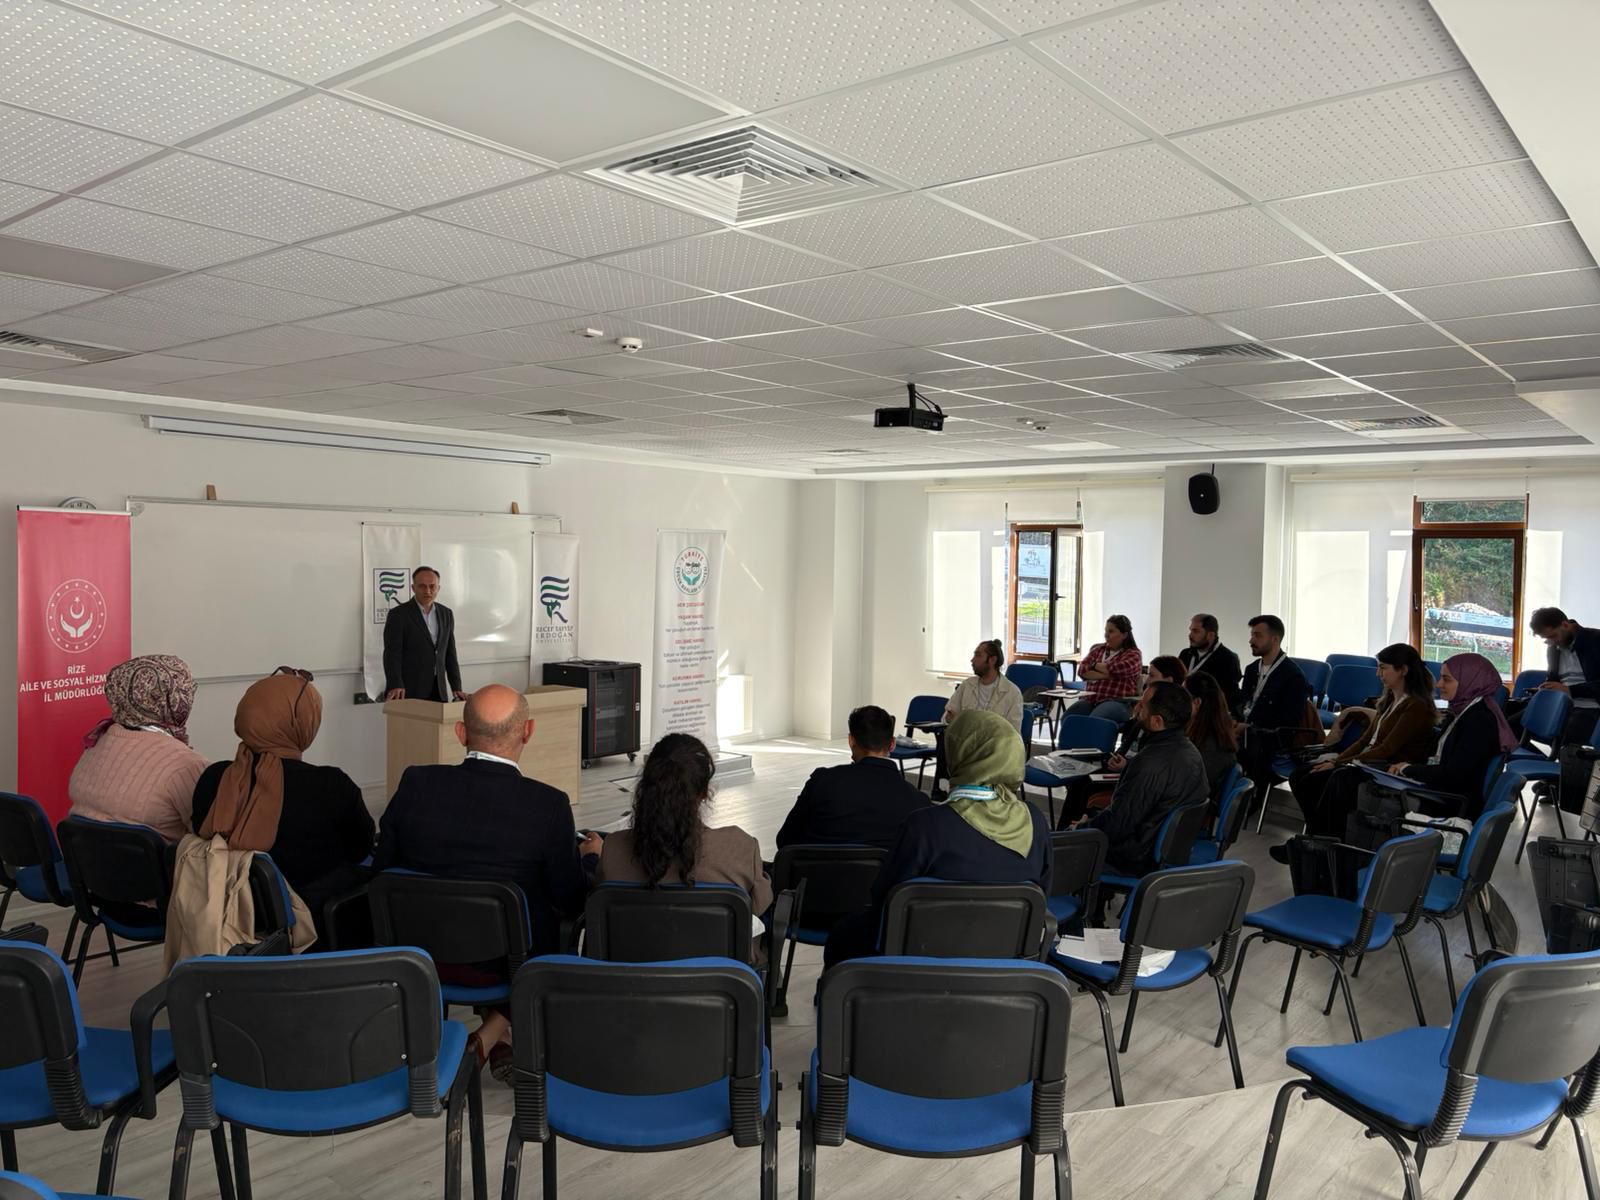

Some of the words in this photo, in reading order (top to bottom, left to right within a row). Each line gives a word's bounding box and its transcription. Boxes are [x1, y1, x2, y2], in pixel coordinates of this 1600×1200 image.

[67, 664, 86, 675] RİZE
[20, 681, 39, 693] AİLE
[40, 680, 52, 690] VE
[53, 677, 84, 688] SOSYAL
[85, 673, 107, 683] HİZM
[44, 691, 52, 702] İL
